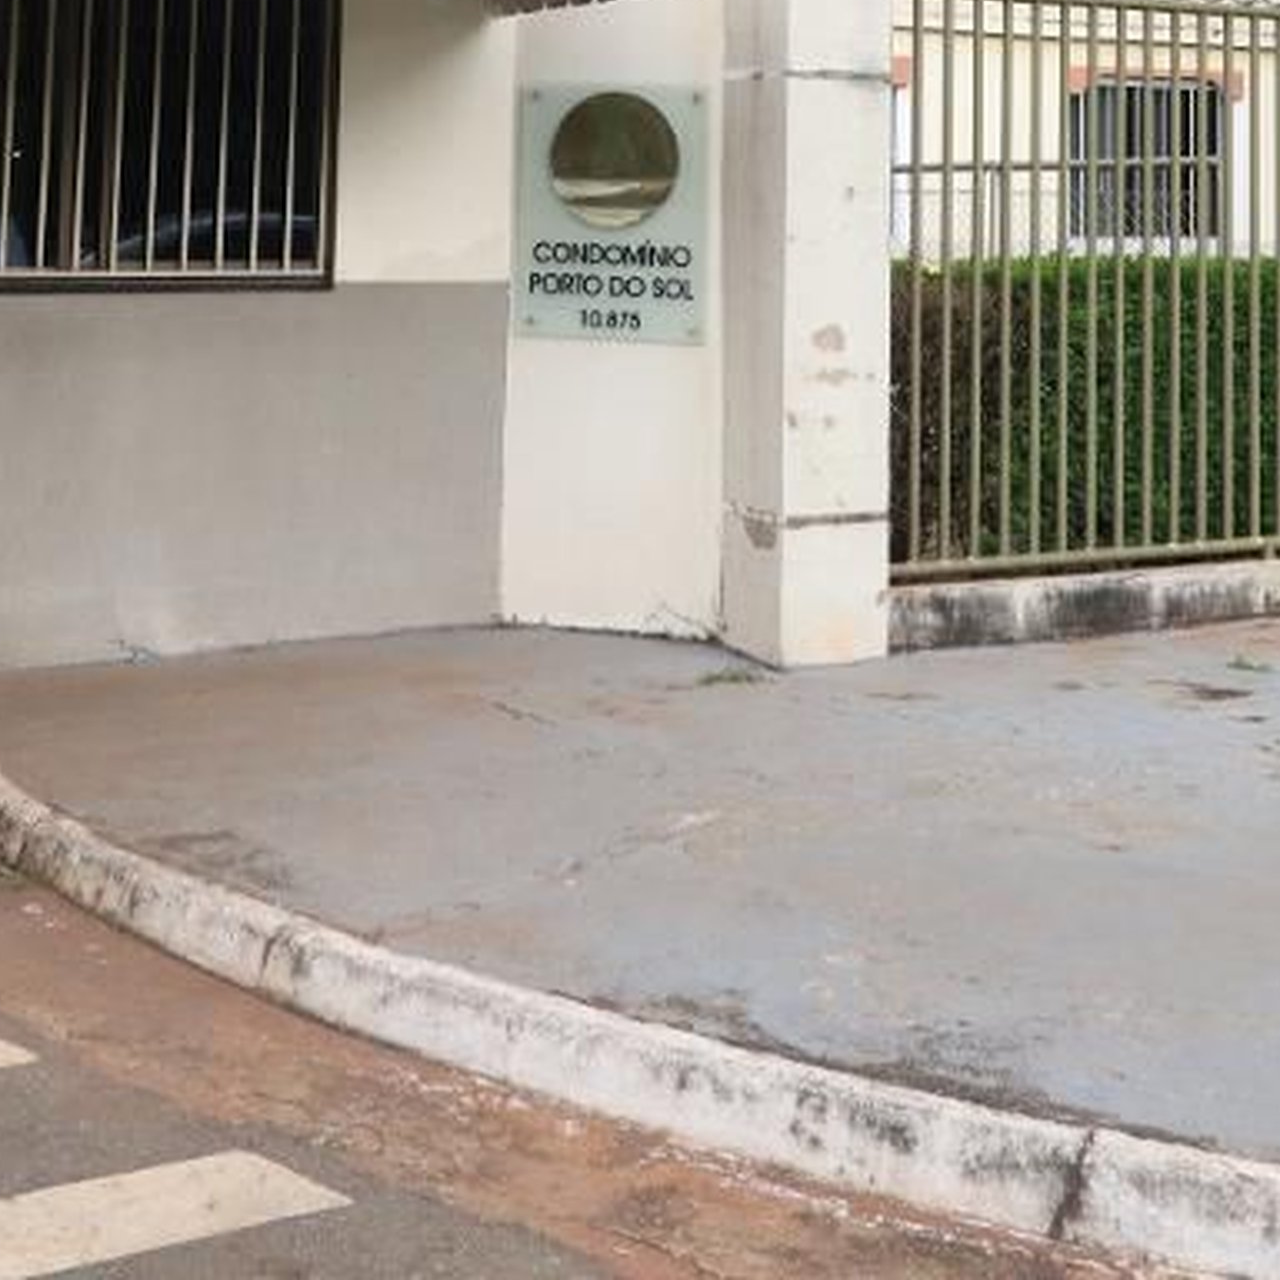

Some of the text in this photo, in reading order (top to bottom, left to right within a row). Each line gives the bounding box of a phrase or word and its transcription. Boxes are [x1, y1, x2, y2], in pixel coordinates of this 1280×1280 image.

[532, 239, 692, 268] CONDOMÍNIO
[528, 272, 694, 300] PORTO DO SOL
